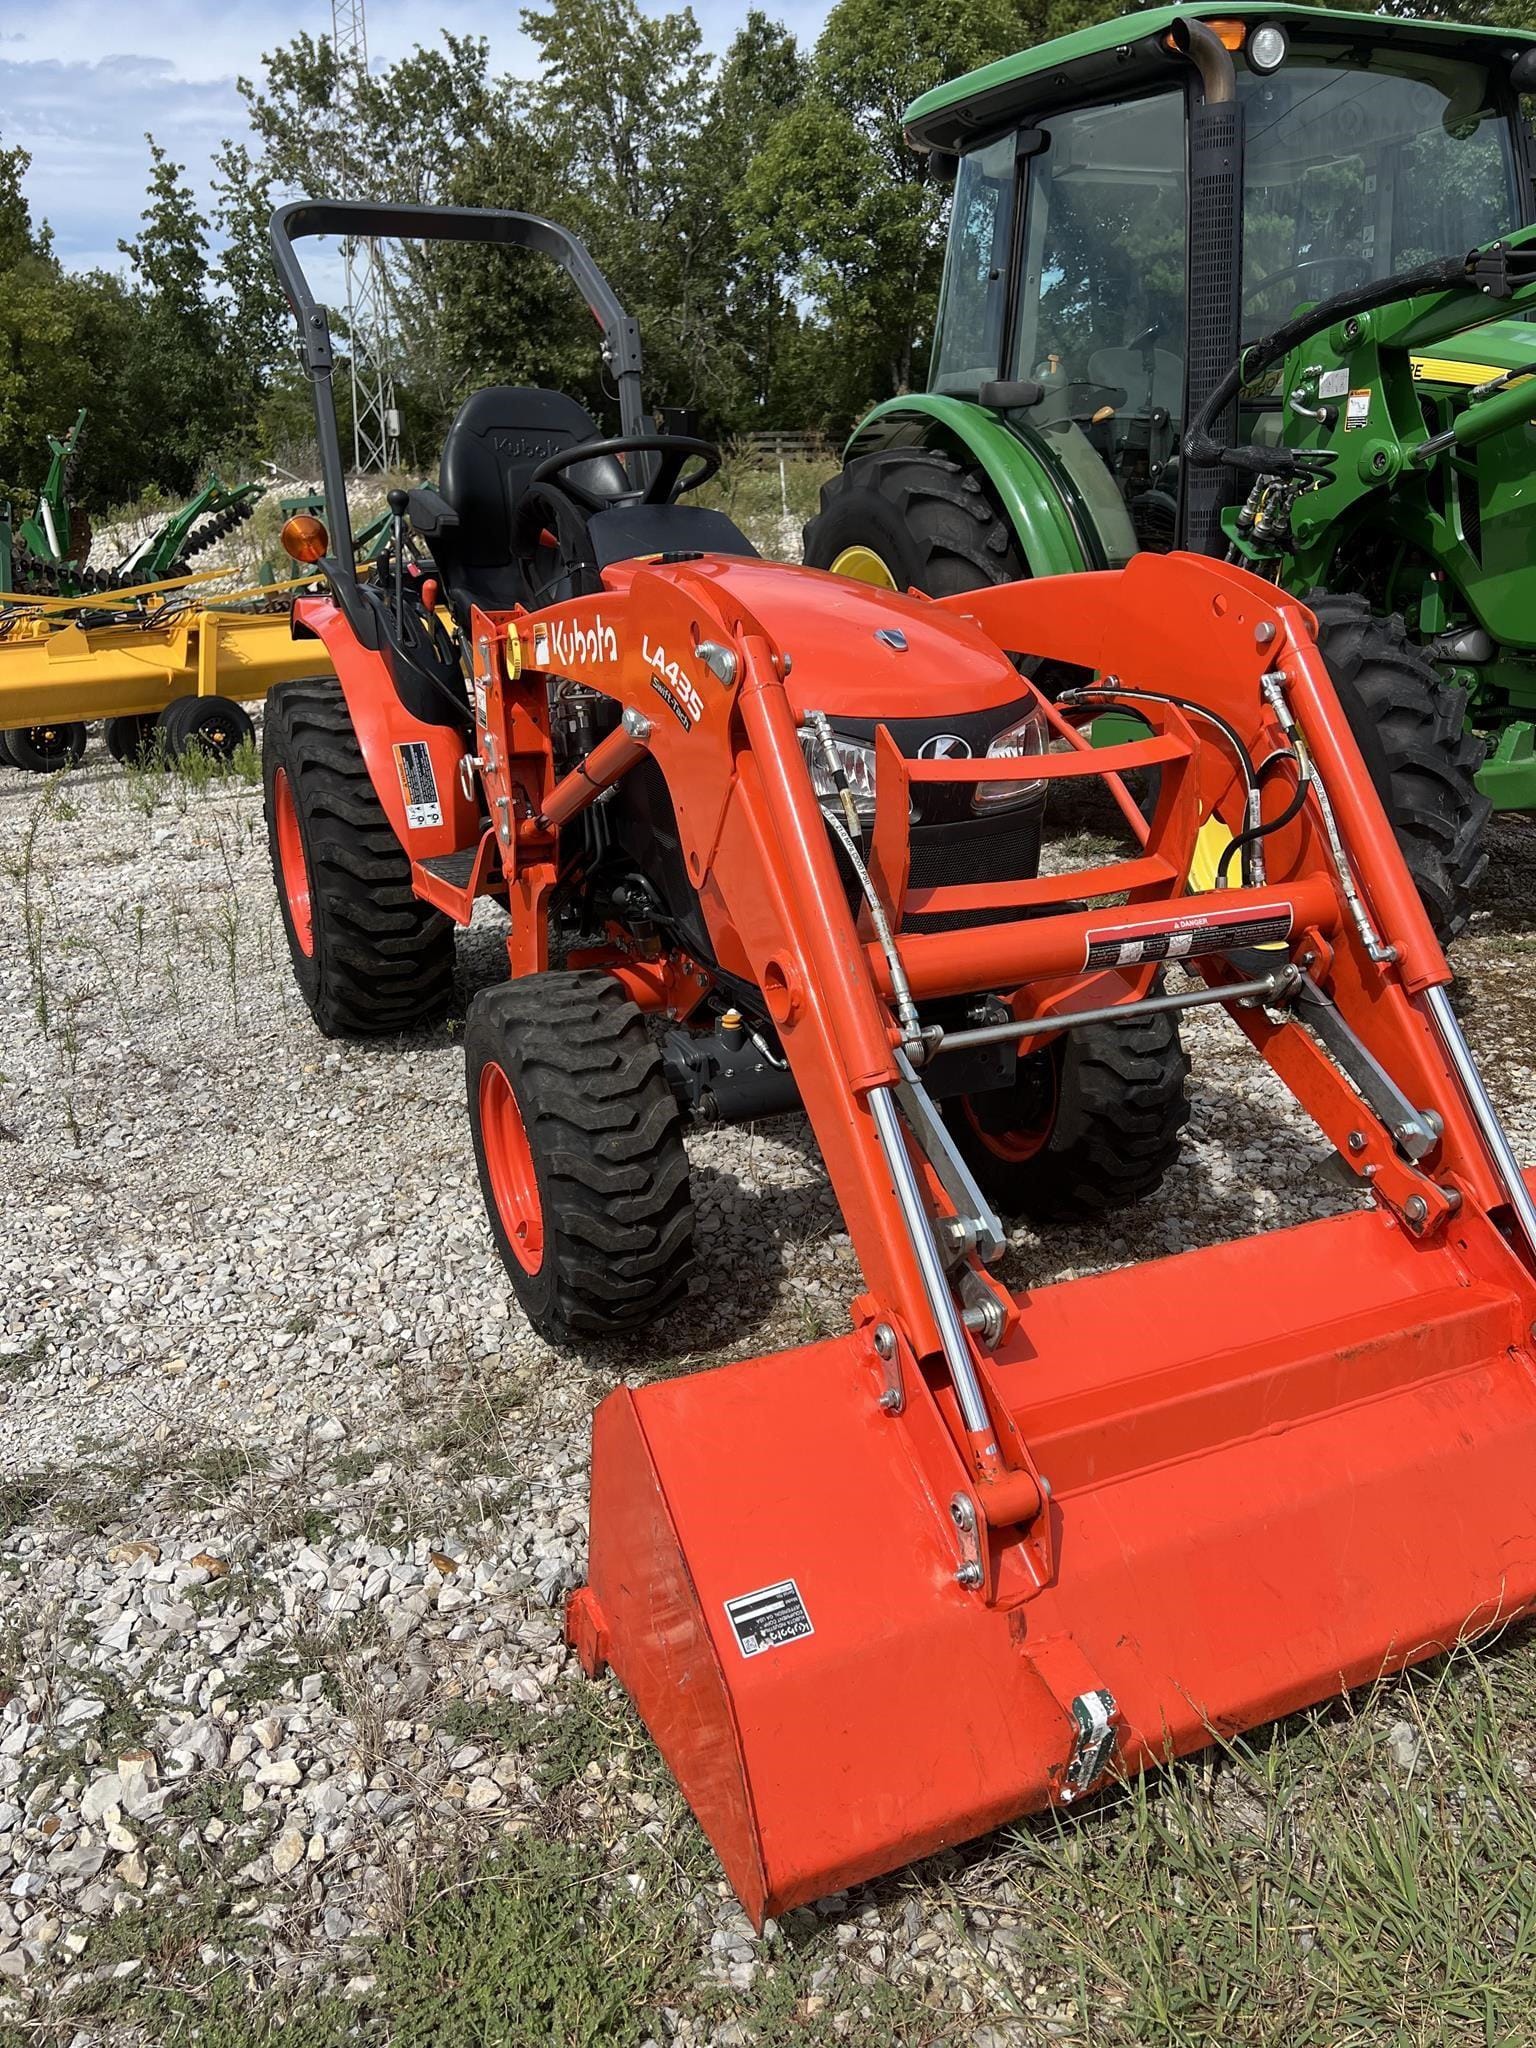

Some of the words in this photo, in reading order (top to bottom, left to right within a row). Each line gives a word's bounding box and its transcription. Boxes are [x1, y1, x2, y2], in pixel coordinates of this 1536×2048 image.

[551, 614, 617, 665] Kubota
[641, 634, 704, 722] LA435
[652, 676, 690, 729] Swift-Tach
[1180, 917, 1209, 928] DANGER
[769, 1622, 810, 1640] Kubota
